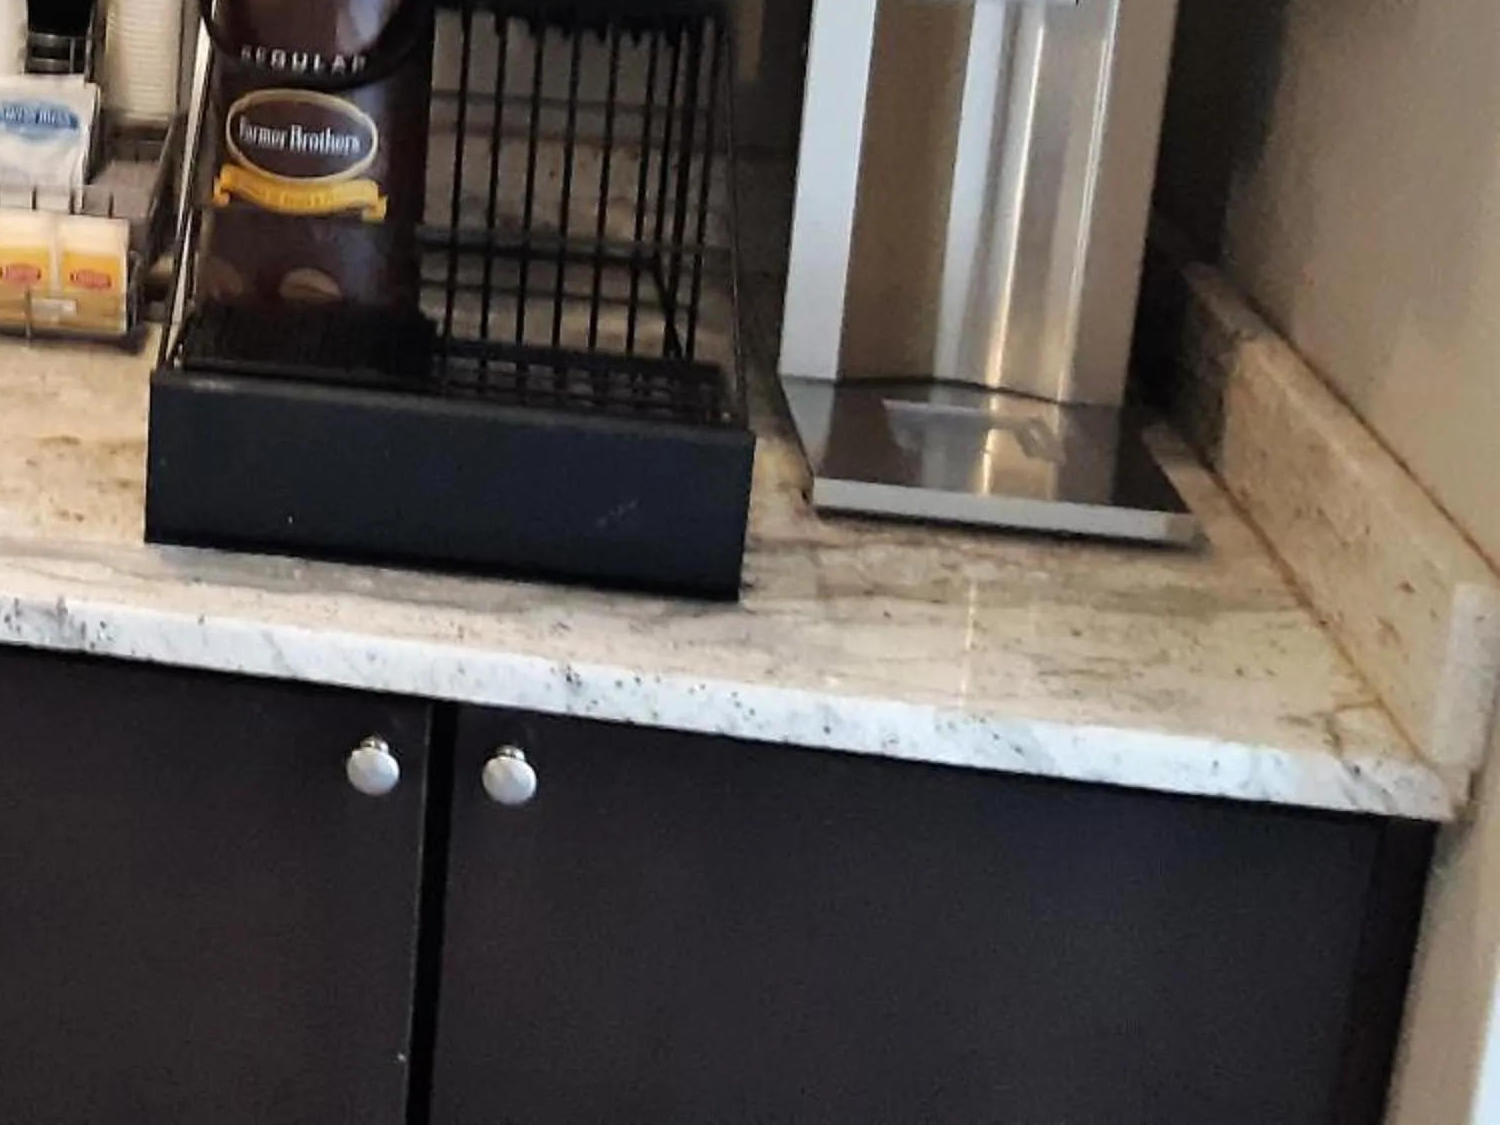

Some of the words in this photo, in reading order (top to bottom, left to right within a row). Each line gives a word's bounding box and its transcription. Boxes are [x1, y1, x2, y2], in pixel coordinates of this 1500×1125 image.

[240, 44, 367, 74] REGULAR
[238, 114, 288, 152] Farmer
[289, 124, 362, 156] Brothers
